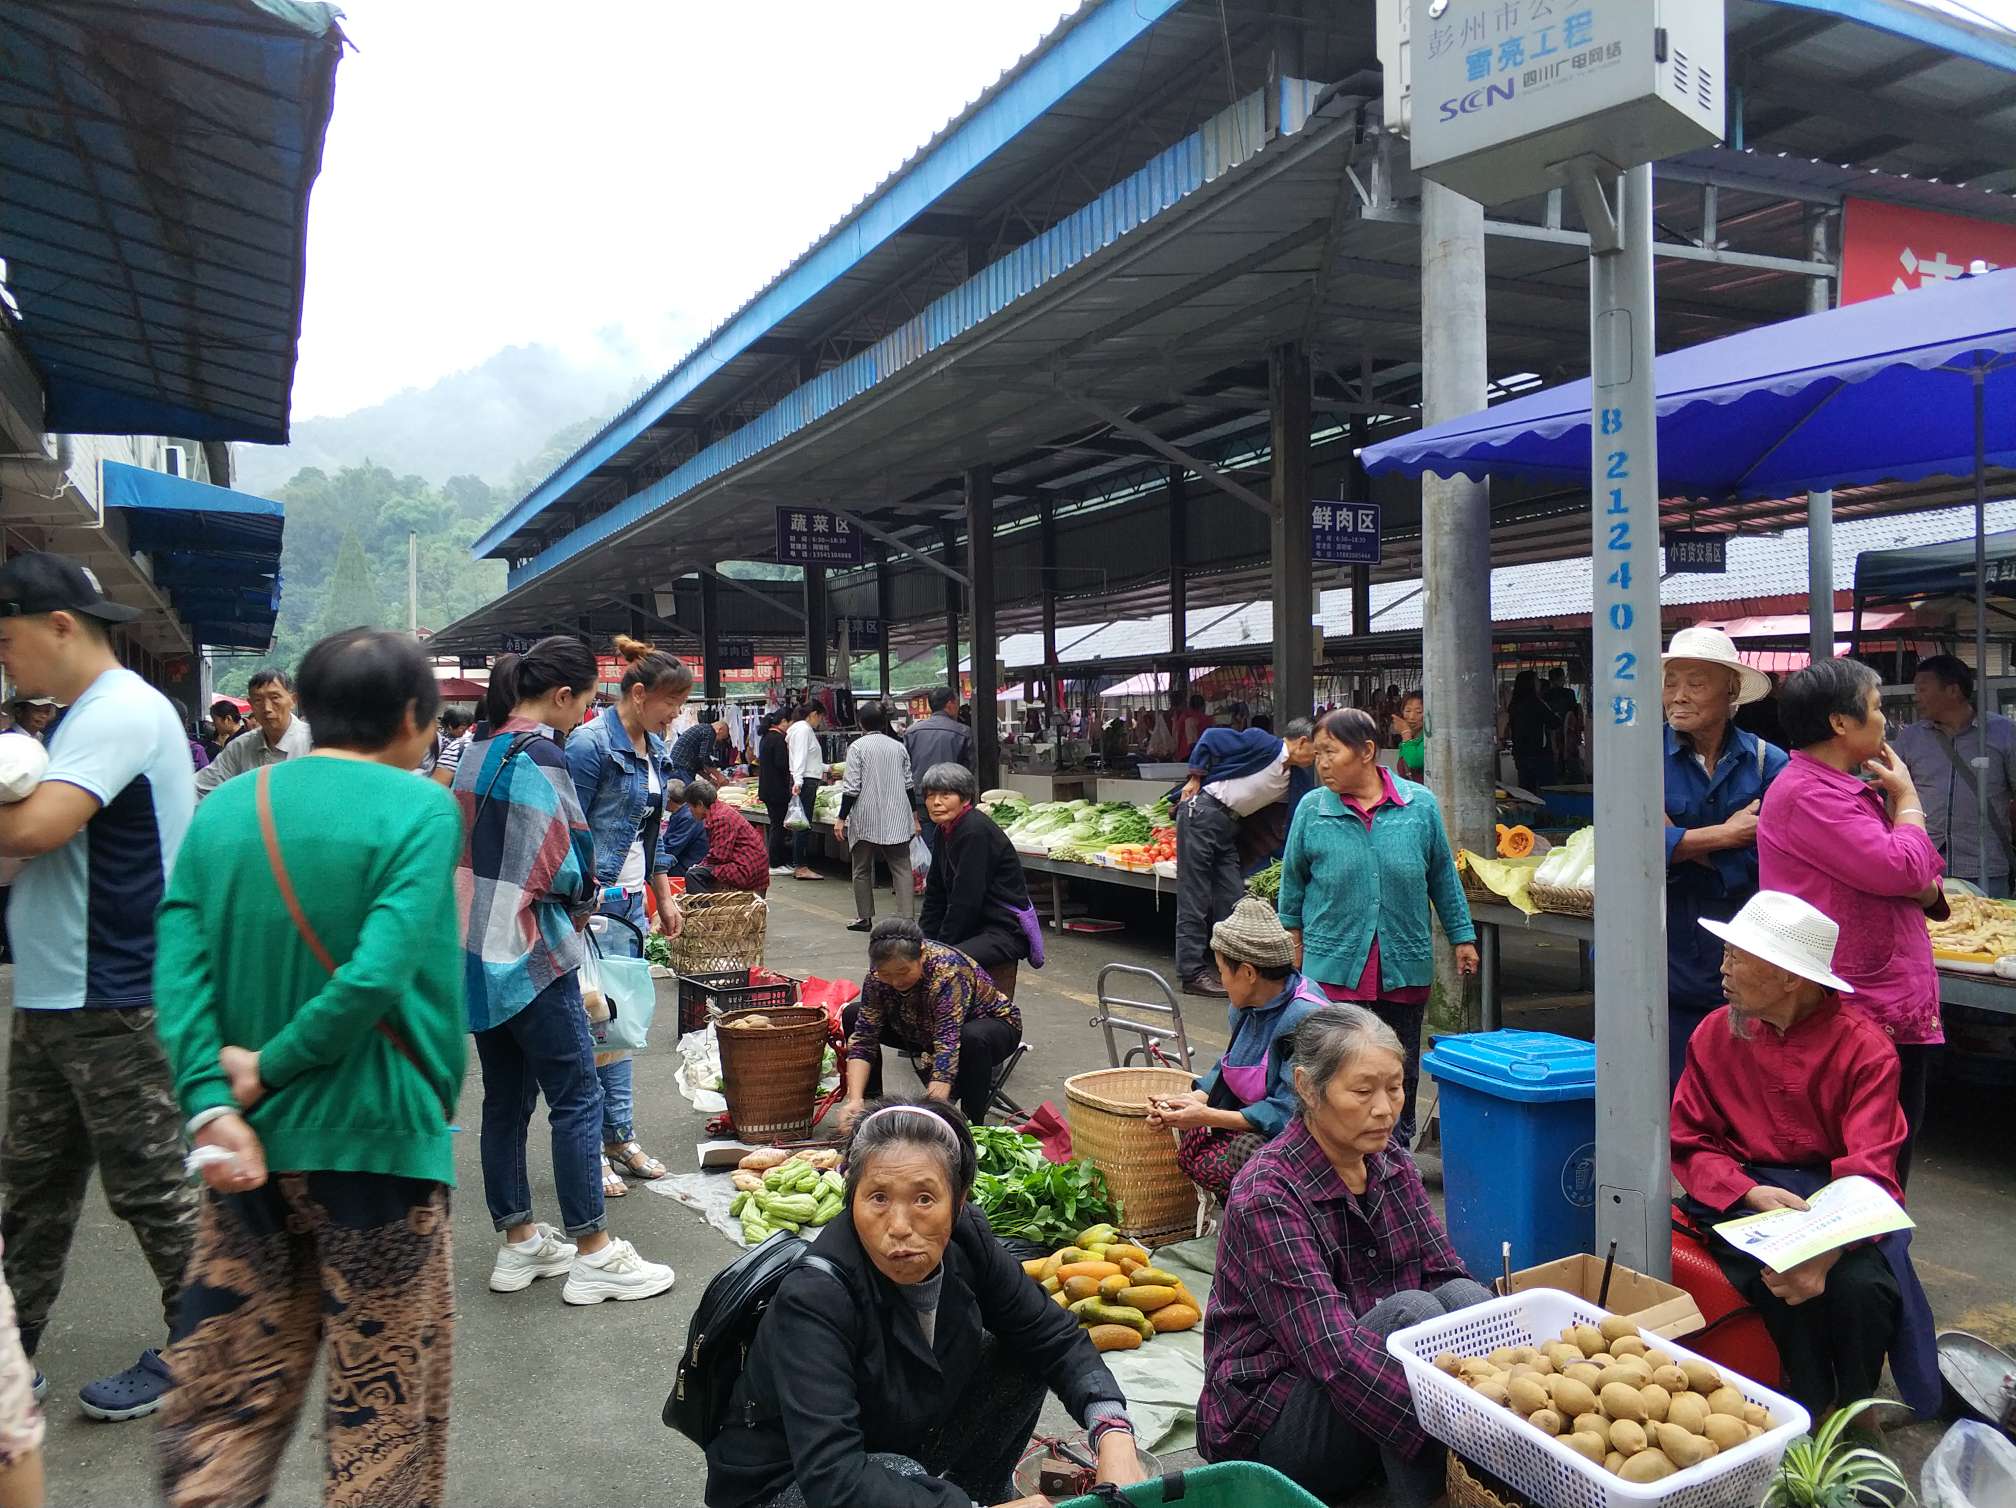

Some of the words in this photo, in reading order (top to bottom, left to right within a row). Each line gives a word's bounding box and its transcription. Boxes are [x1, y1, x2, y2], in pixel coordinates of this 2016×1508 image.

[1427, 0, 1578, 60] 彭州市公
[1466, 10, 1594, 82] 雪亮工程
[1523, 40, 1622, 88] 四川广电网络
[790, 513, 851, 534] 蔬菜区
[1312, 505, 1376, 533] 鲜肉区
[1671, 542, 1722, 563] 小百货交易区
